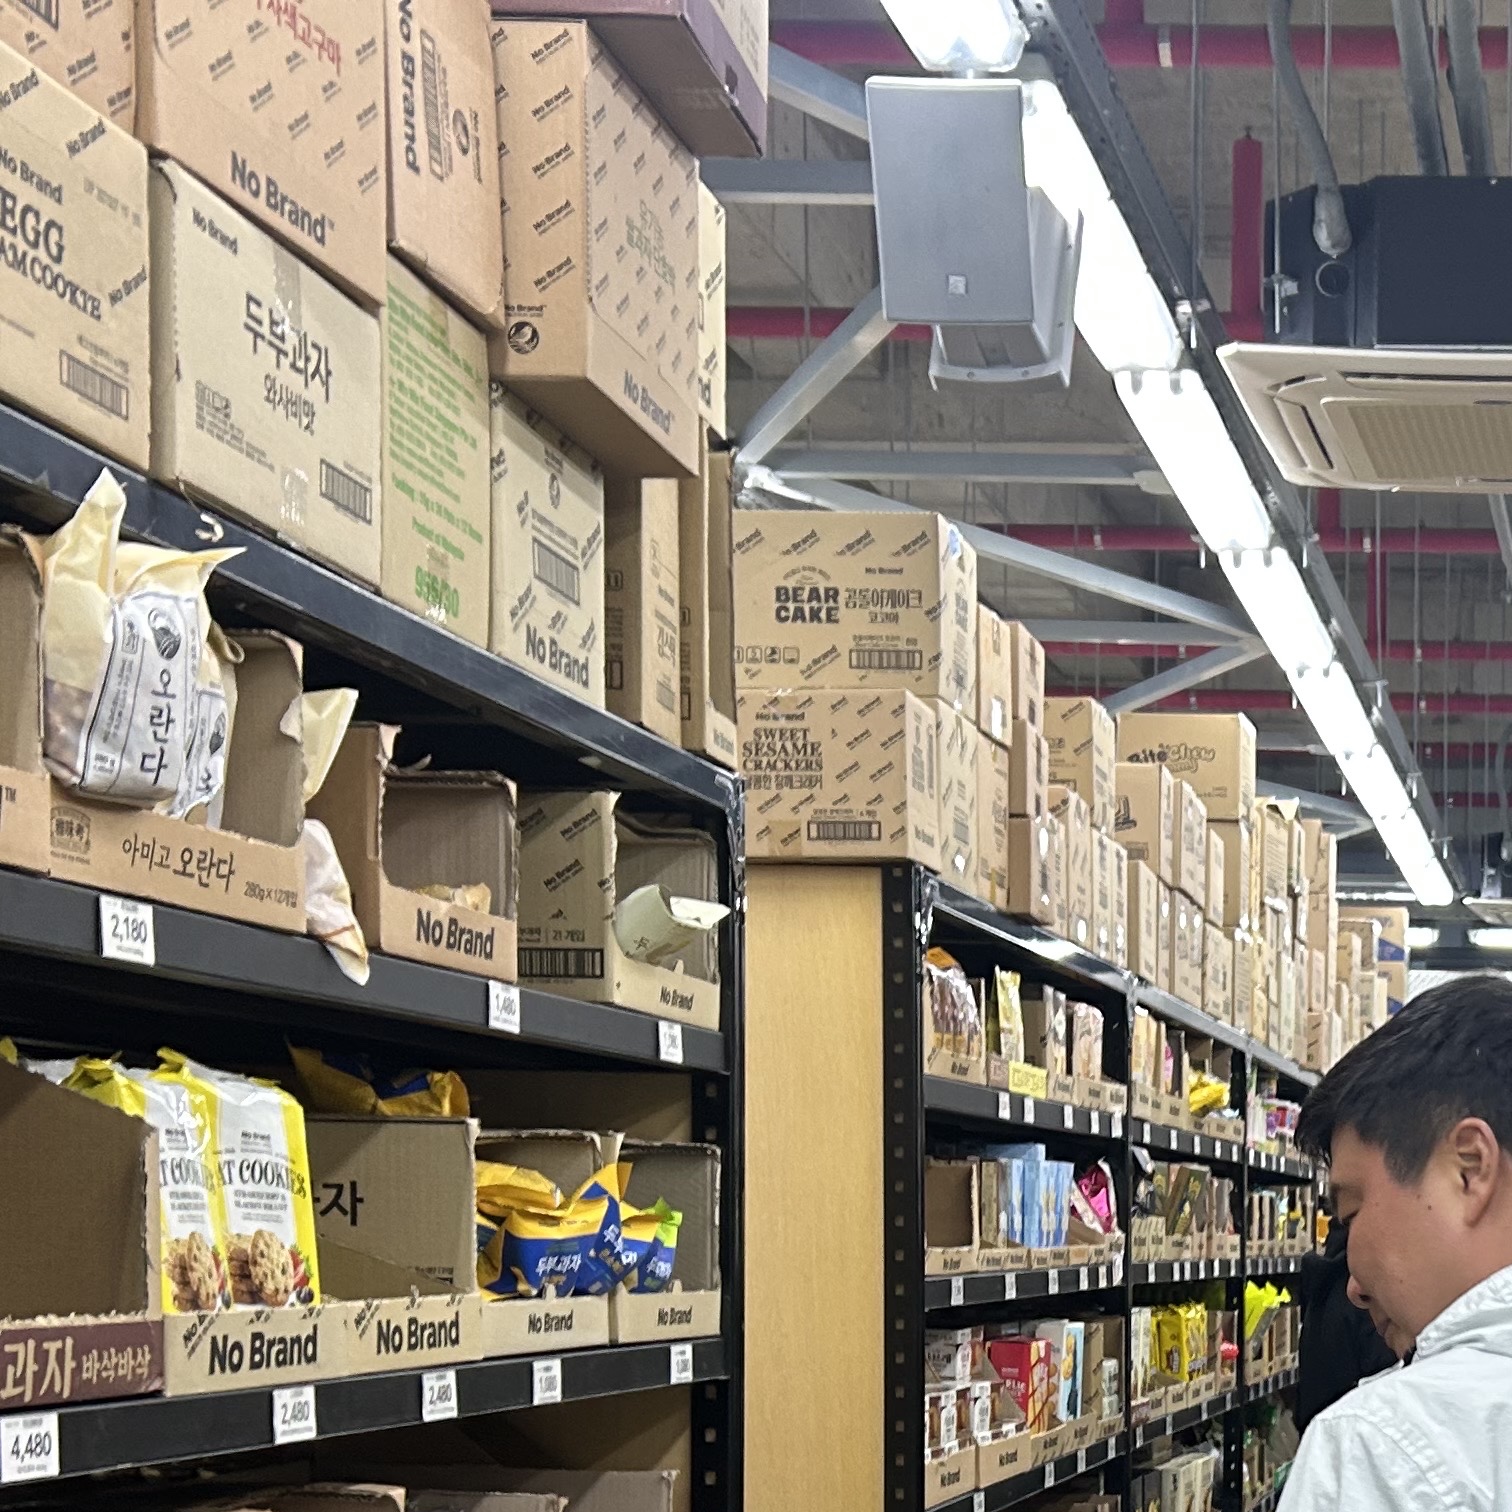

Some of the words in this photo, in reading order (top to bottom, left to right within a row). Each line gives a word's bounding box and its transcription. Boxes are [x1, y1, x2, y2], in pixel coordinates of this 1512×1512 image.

[531, 47, 544, 60] No
[546, 28, 570, 51] Brand
[401, 50, 420, 176] Brand
[531, 104, 545, 118] No
[547, 85, 571, 107] Brand
[78, 118, 106, 149] Brand
[532, 162, 545, 175] No
[548, 142, 571, 164] Brand
[20, 160, 63, 205] Brand
[230, 151, 261, 199] No
[265, 176, 328, 246] Brand
[192, 207, 206, 235] No
[207, 217, 238, 256] Brand
[533, 218, 546, 232] No
[549, 199, 572, 222] Brand
[121, 265, 147, 298] Brand
[533, 275, 546, 288] No
[549, 256, 572, 279] Brand
[243, 291, 332, 402] 두부과자
[623, 369, 639, 404] No
[775, 586, 840, 604] BEAR
[775, 605, 840, 623] CAKE
[526, 623, 546, 665] No
[548, 640, 590, 690] Brand
[140, 667, 176, 786] 오란다
[753, 727, 810, 742] SWEET
[742, 741, 823, 759] SESAME
[742, 758, 824, 774] CRACKERS
[573, 808, 599, 832] Brand
[122, 833, 171, 871] 아미고
[172, 847, 236, 894] 오란다
[544, 876, 557, 891] No
[556, 859, 581, 883] Brand
[111, 914, 147, 944] 2,180
[416, 909, 442, 947] No
[446, 917, 494, 961] Brand
[660, 986, 671, 1004] No
[671, 990, 695, 1012] Brand
[528, 1314, 541, 1335] No
[543, 1310, 574, 1333] Brand
[657, 1308, 668, 1327] No
[669, 1306, 693, 1327] Brand
[208, 1334, 244, 1376] No
[249, 1324, 318, 1371] Brand
[376, 1319, 401, 1356] No
[406, 1311, 460, 1350] Brand
[10, 1432, 52, 1462] 4,480
